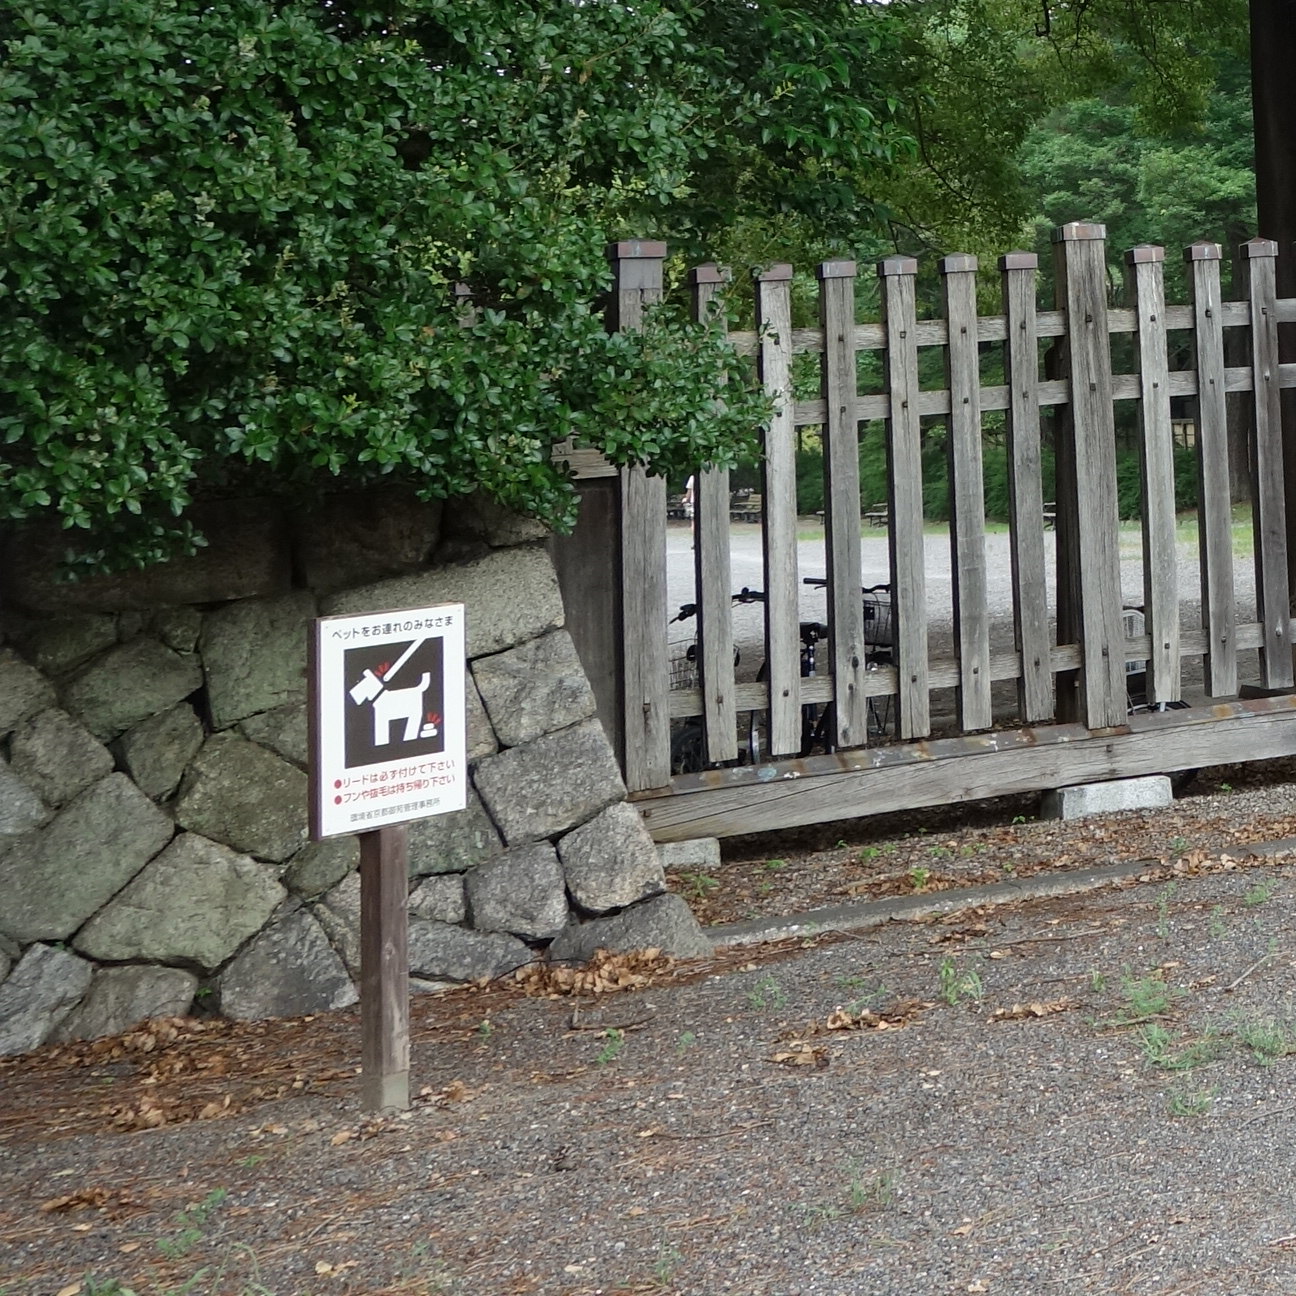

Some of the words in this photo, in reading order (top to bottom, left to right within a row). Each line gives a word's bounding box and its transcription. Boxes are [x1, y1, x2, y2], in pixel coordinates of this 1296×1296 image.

[332, 615, 454, 640] ペットをお連れのみなさま
[343, 759, 455, 788] リードは必ず付けて下さい
